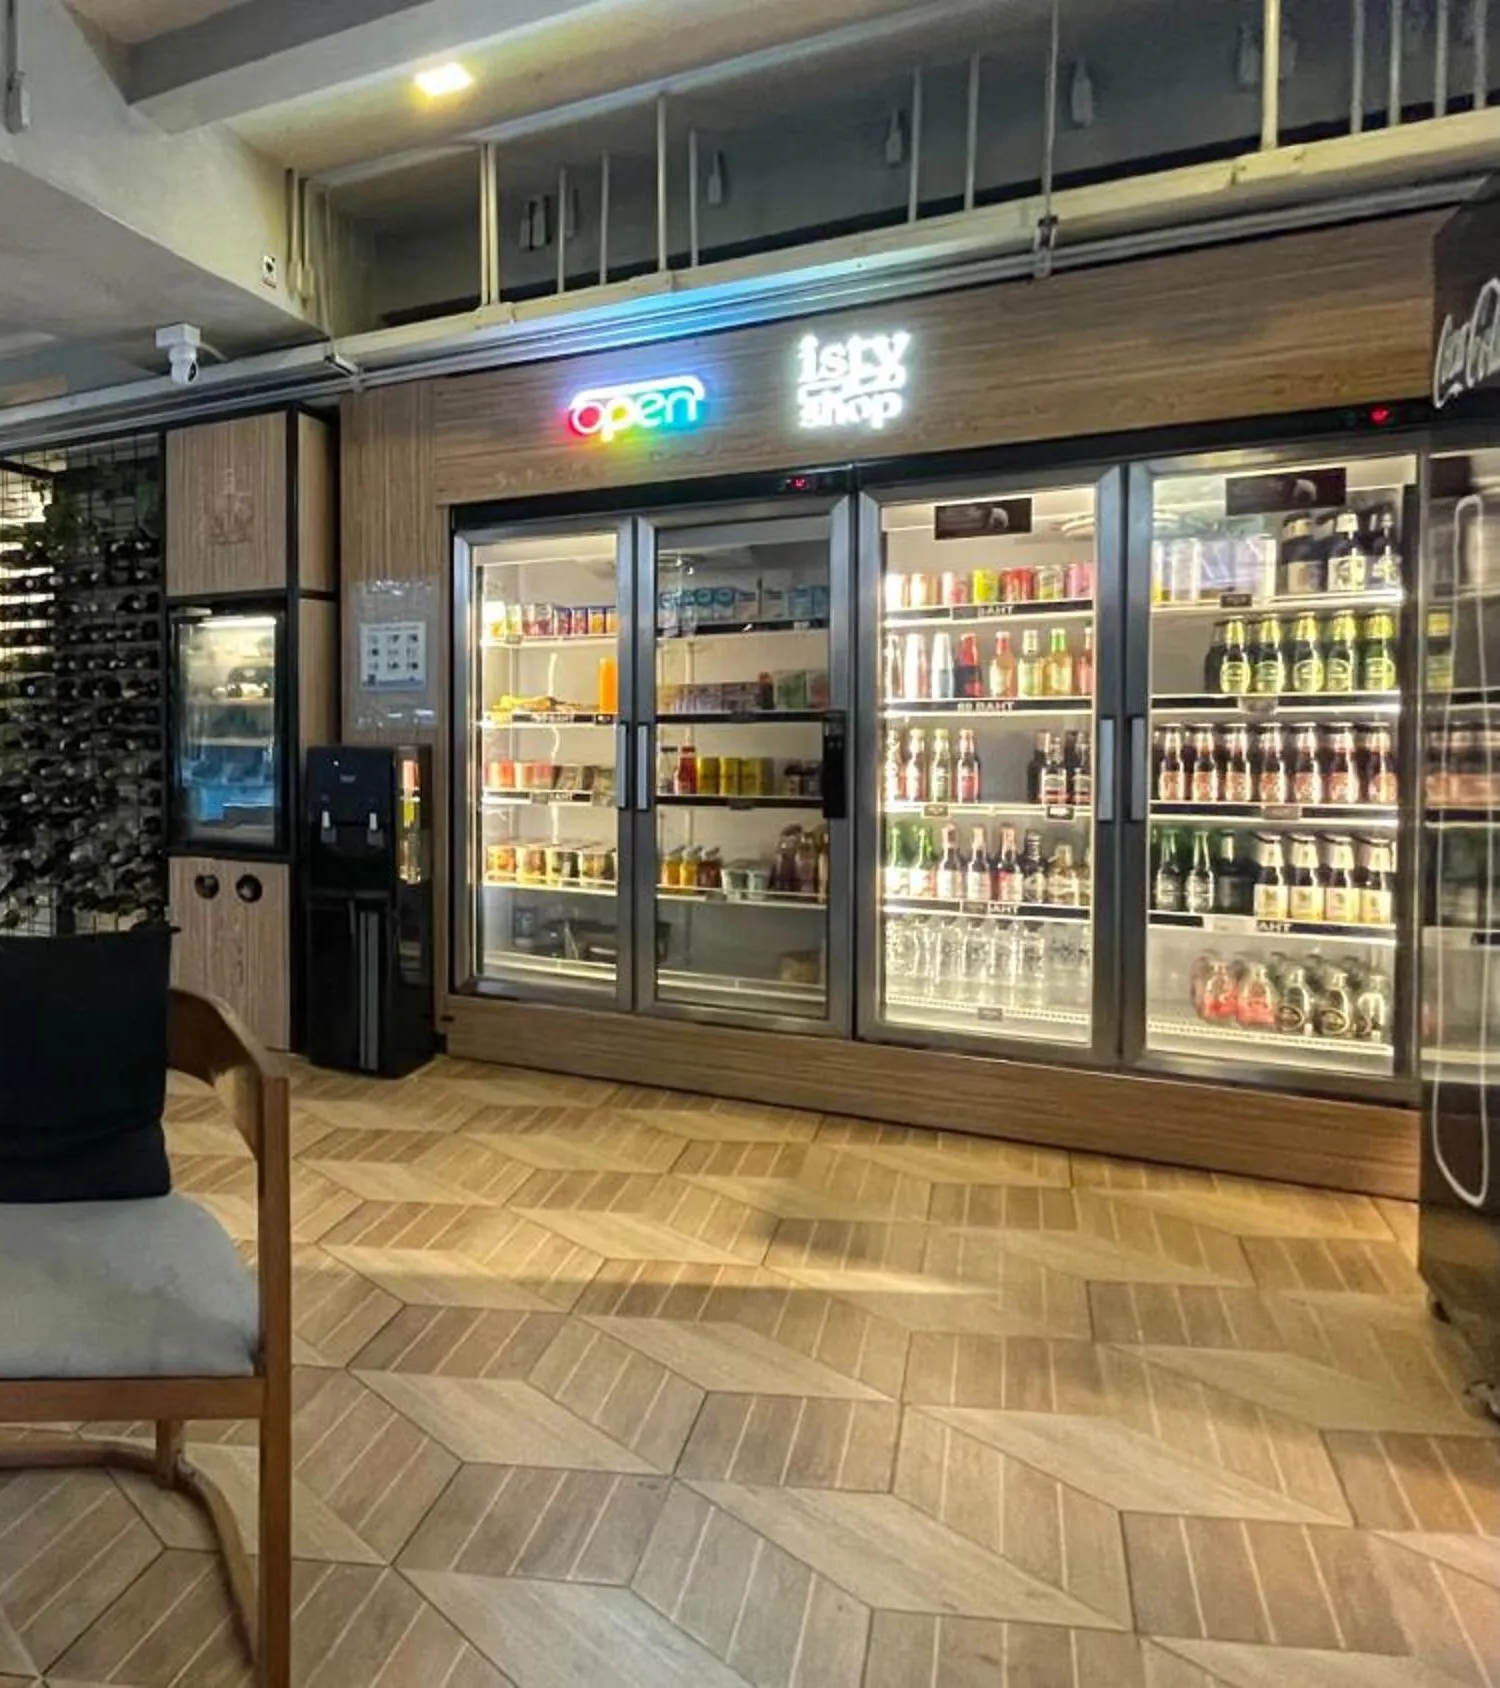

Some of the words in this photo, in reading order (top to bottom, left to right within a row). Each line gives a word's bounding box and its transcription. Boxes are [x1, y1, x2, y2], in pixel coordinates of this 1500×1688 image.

[570, 377, 703, 442] open
[797, 386, 904, 430] shop
[975, 700, 1015, 712] BAHT
[1257, 920, 1292, 934] AHT
